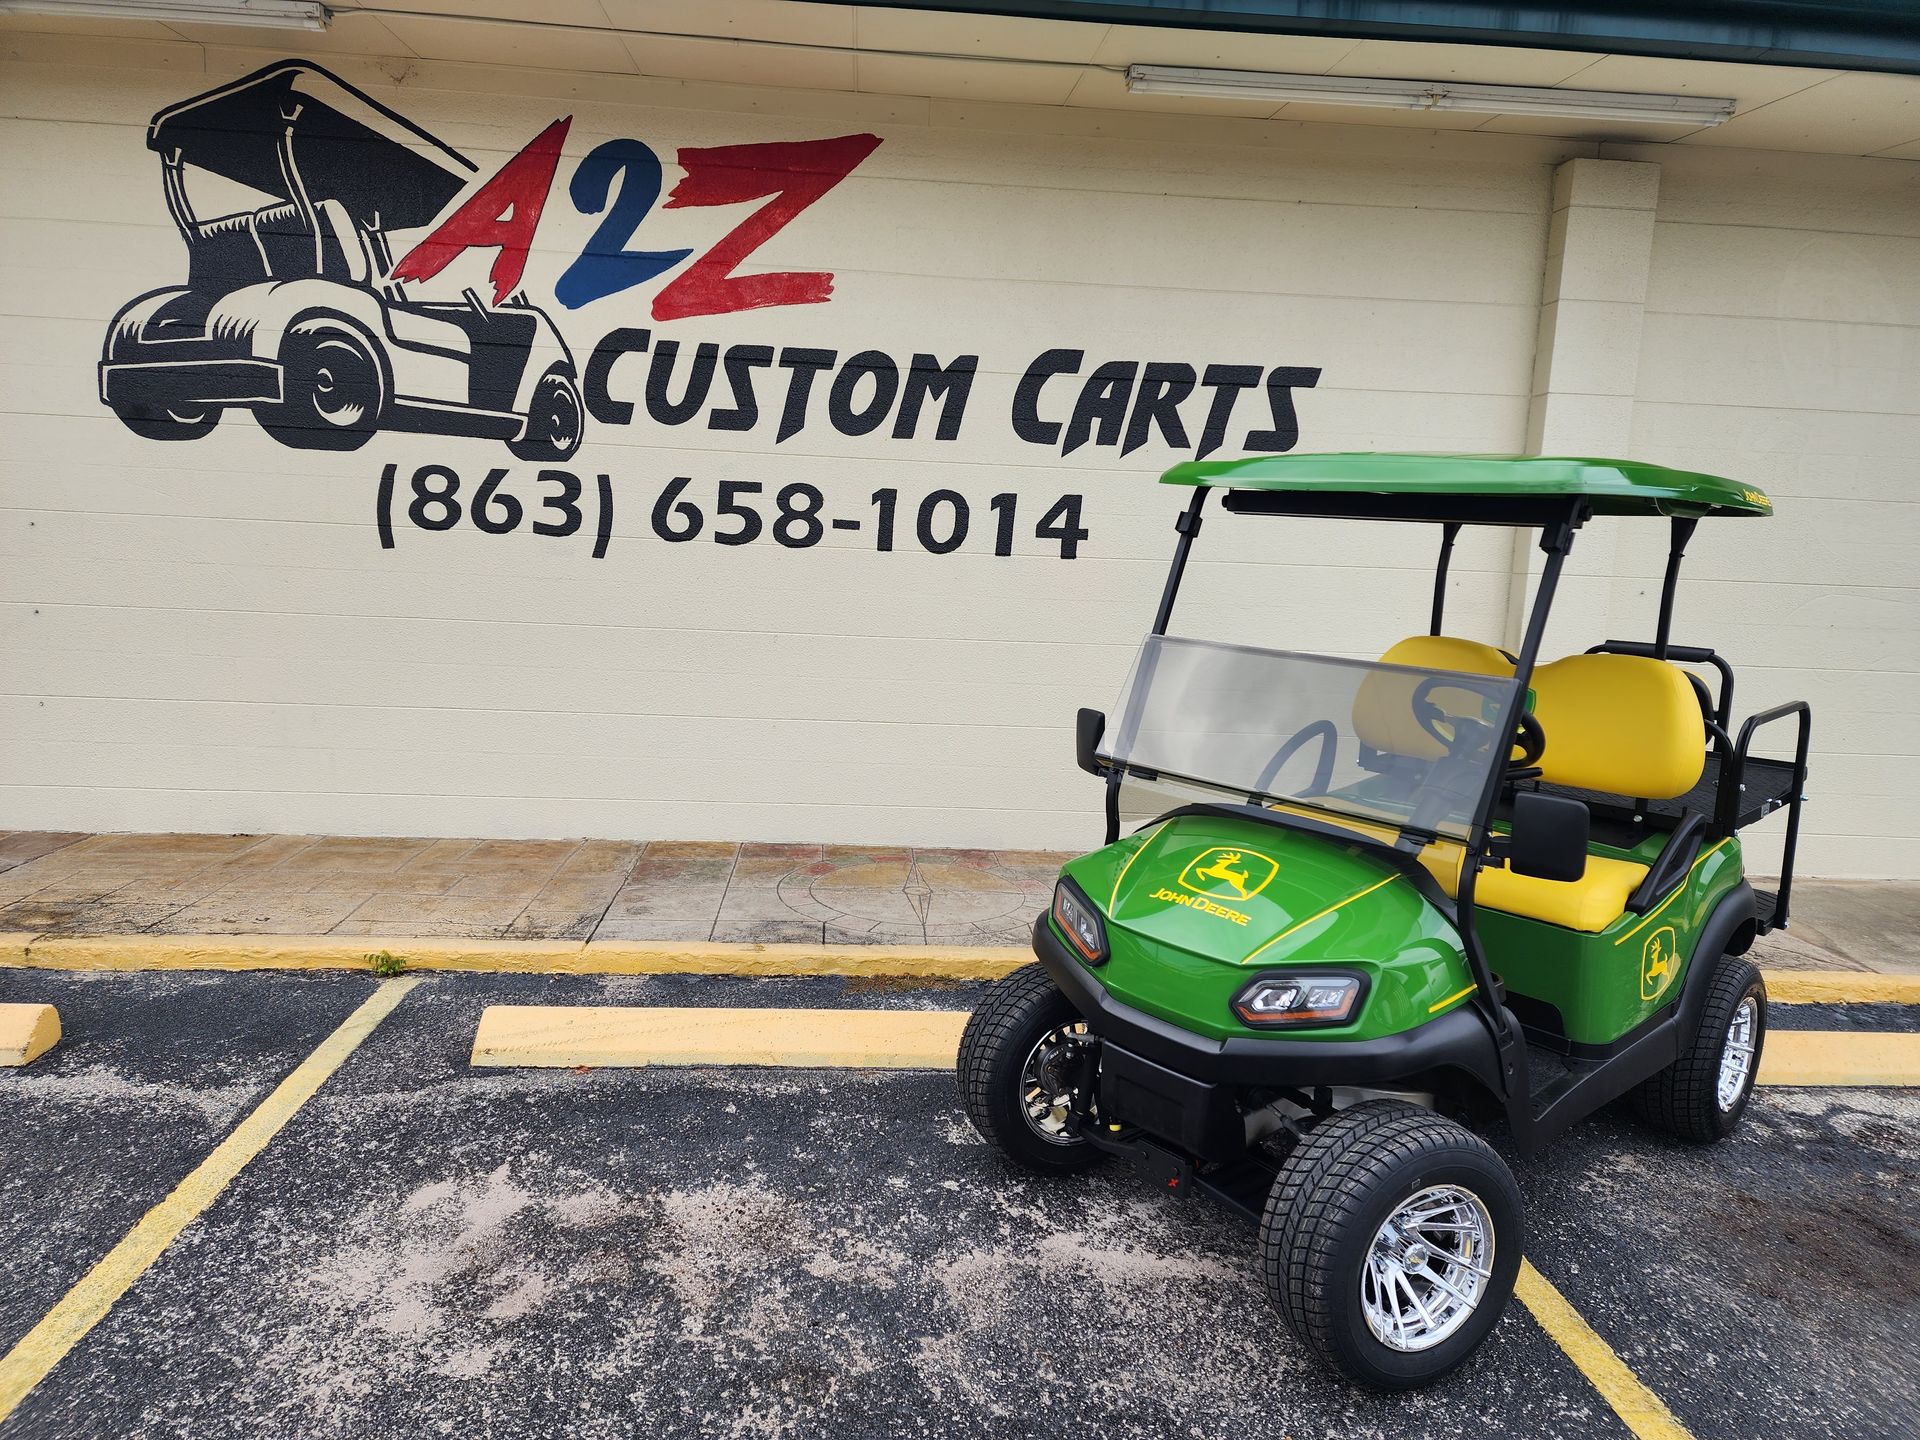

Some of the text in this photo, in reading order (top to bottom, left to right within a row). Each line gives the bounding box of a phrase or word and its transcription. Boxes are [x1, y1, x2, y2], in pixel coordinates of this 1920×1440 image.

[390, 115, 884, 321] A2Z
[583, 327, 1323, 460] CUSTOM CARTS
[376, 463, 1089, 560] (863) 658-1014
[1149, 887, 1252, 927] JOHN DEERE
